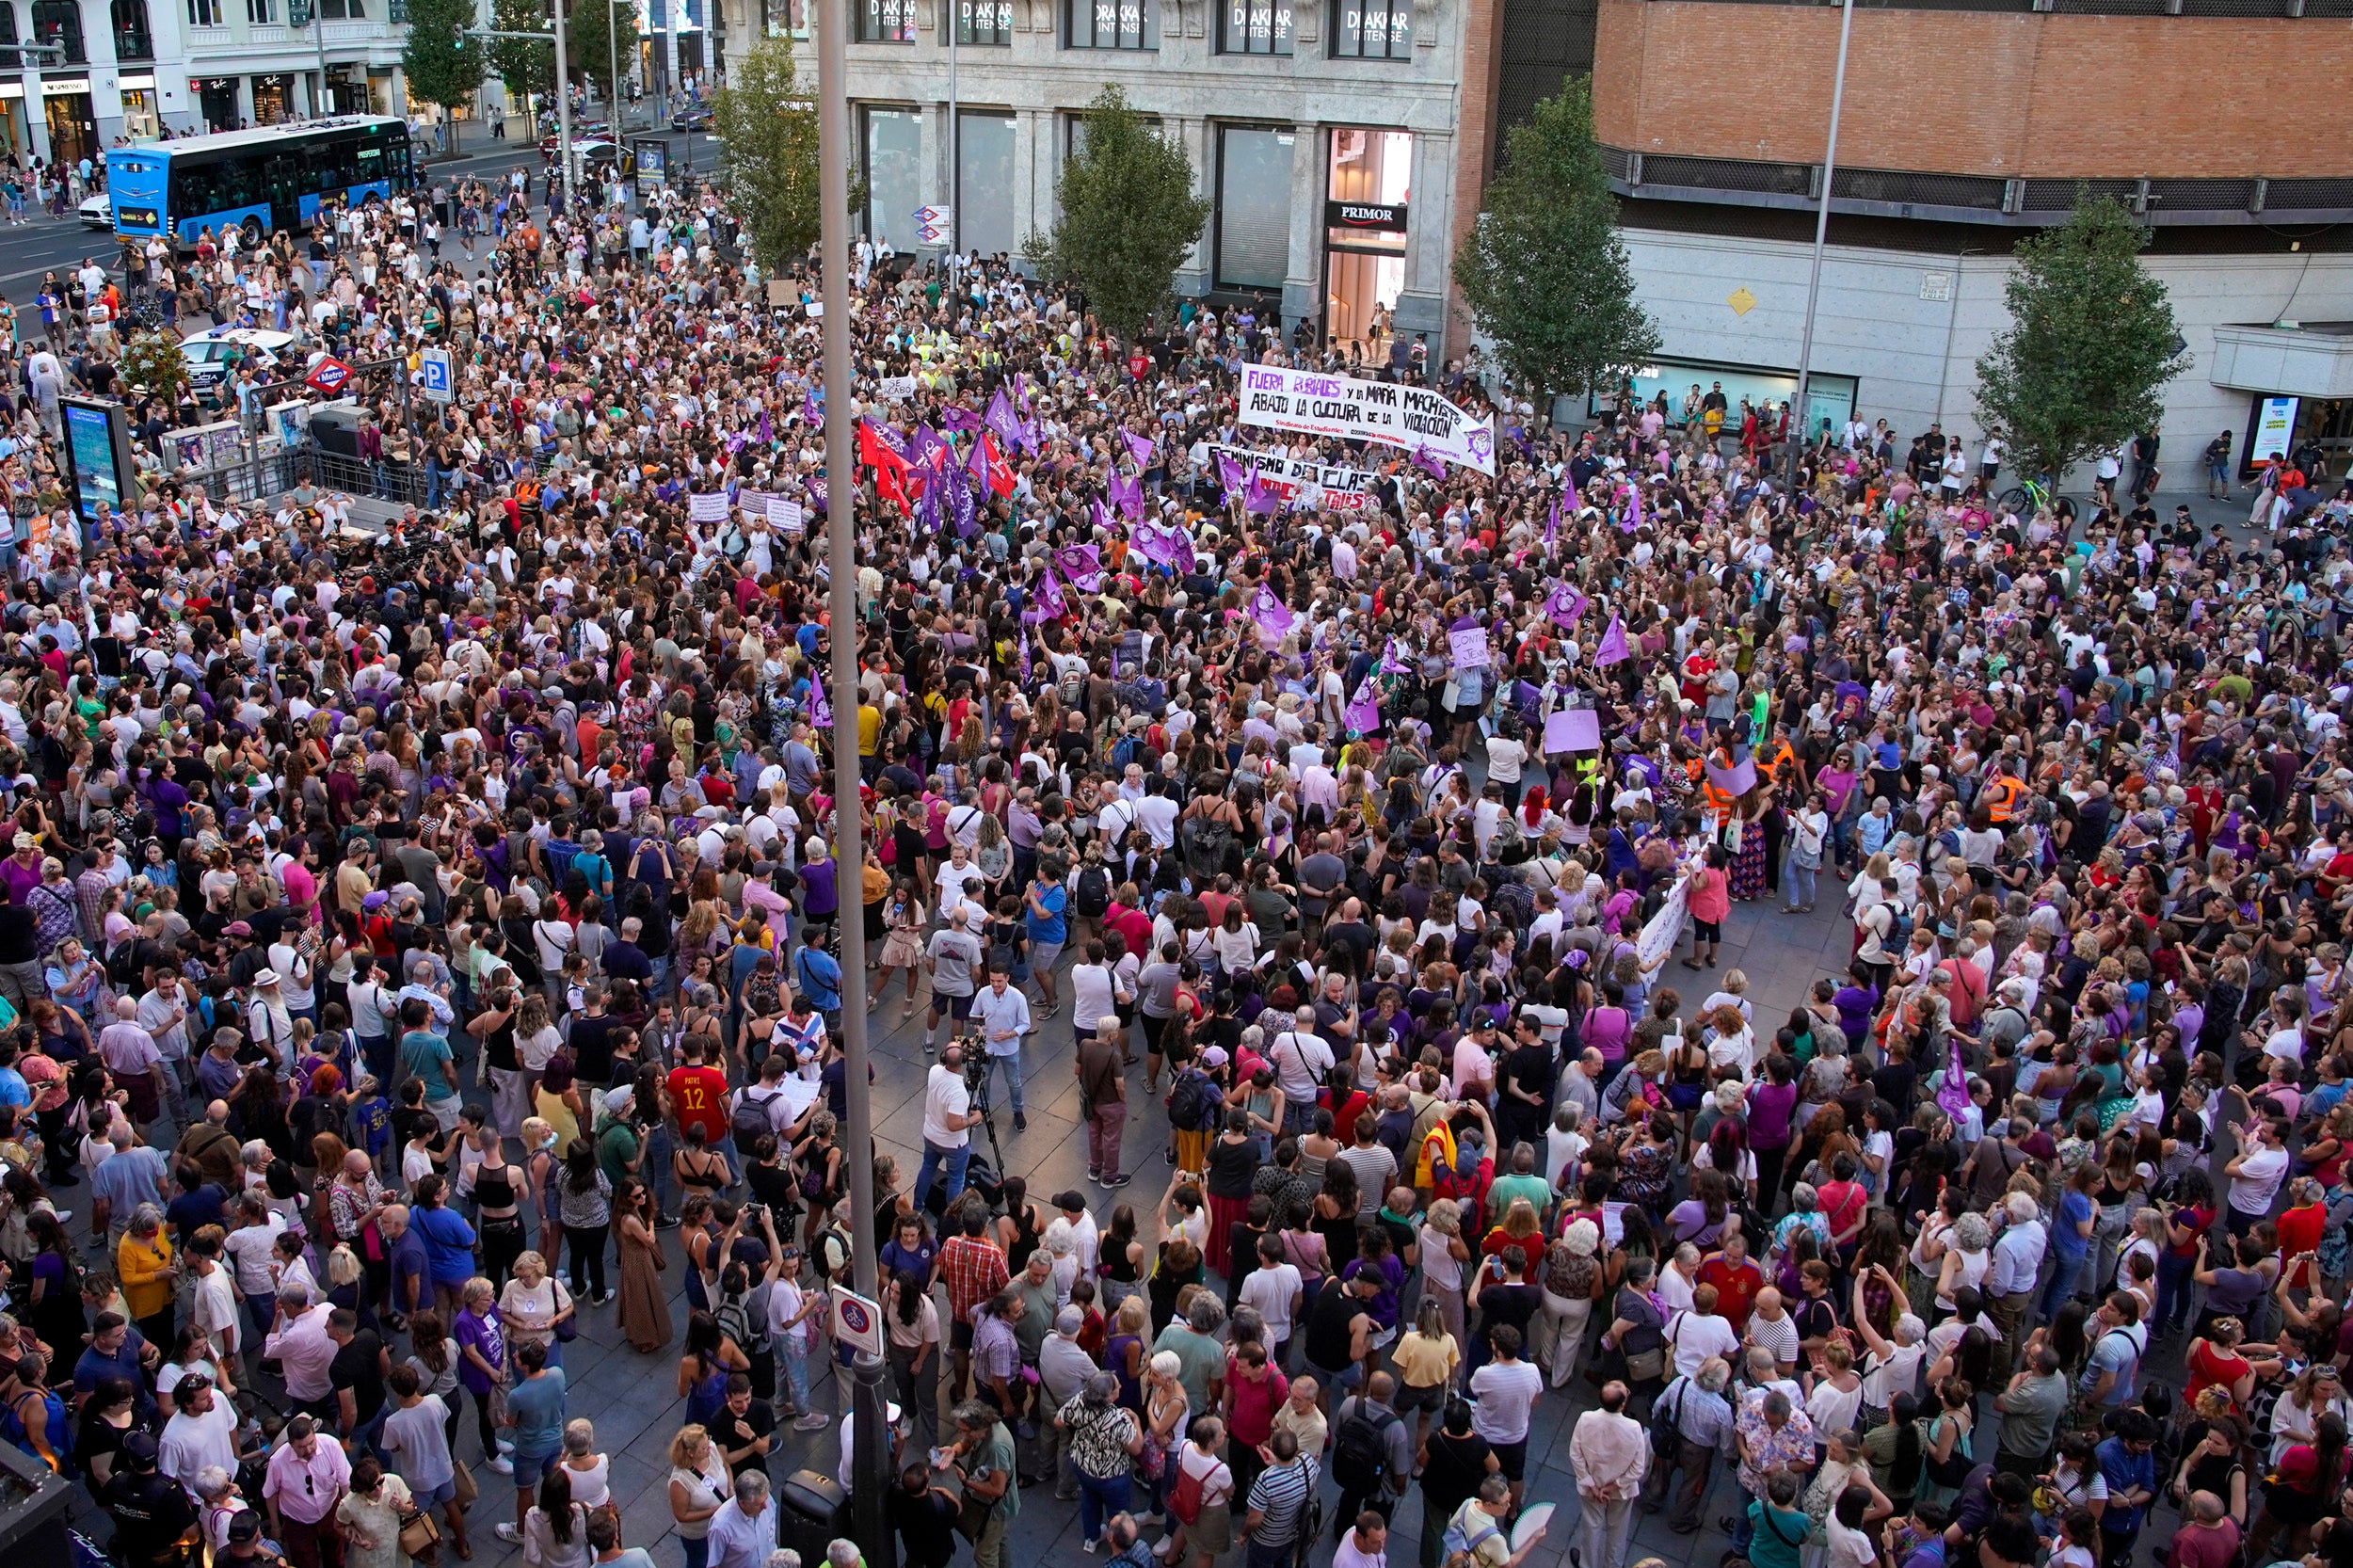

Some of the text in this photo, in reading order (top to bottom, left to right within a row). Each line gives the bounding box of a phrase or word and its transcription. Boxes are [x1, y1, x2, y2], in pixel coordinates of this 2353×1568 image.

[1098, 23, 1140, 33] INTNSE
[1341, 206, 1393, 221] PRIMOR
[321, 371, 344, 382] Metro
[426, 363, 441, 387] P
[1247, 370, 1284, 392] FUERA
[888, 380, 901, 389] SE
[1250, 392, 1289, 414] ABAJO
[1295, 398, 1306, 417] LA
[1312, 400, 1362, 423] CULTURA
[1368, 411, 1378, 424] DE
[1382, 412, 1392, 425] LA
[1209, 446, 1286, 473] FMINISMO
[1321, 469, 1371, 491] CLAS
[684, 1077, 700, 1085] PATRI
[683, 1088, 706, 1111] 12
